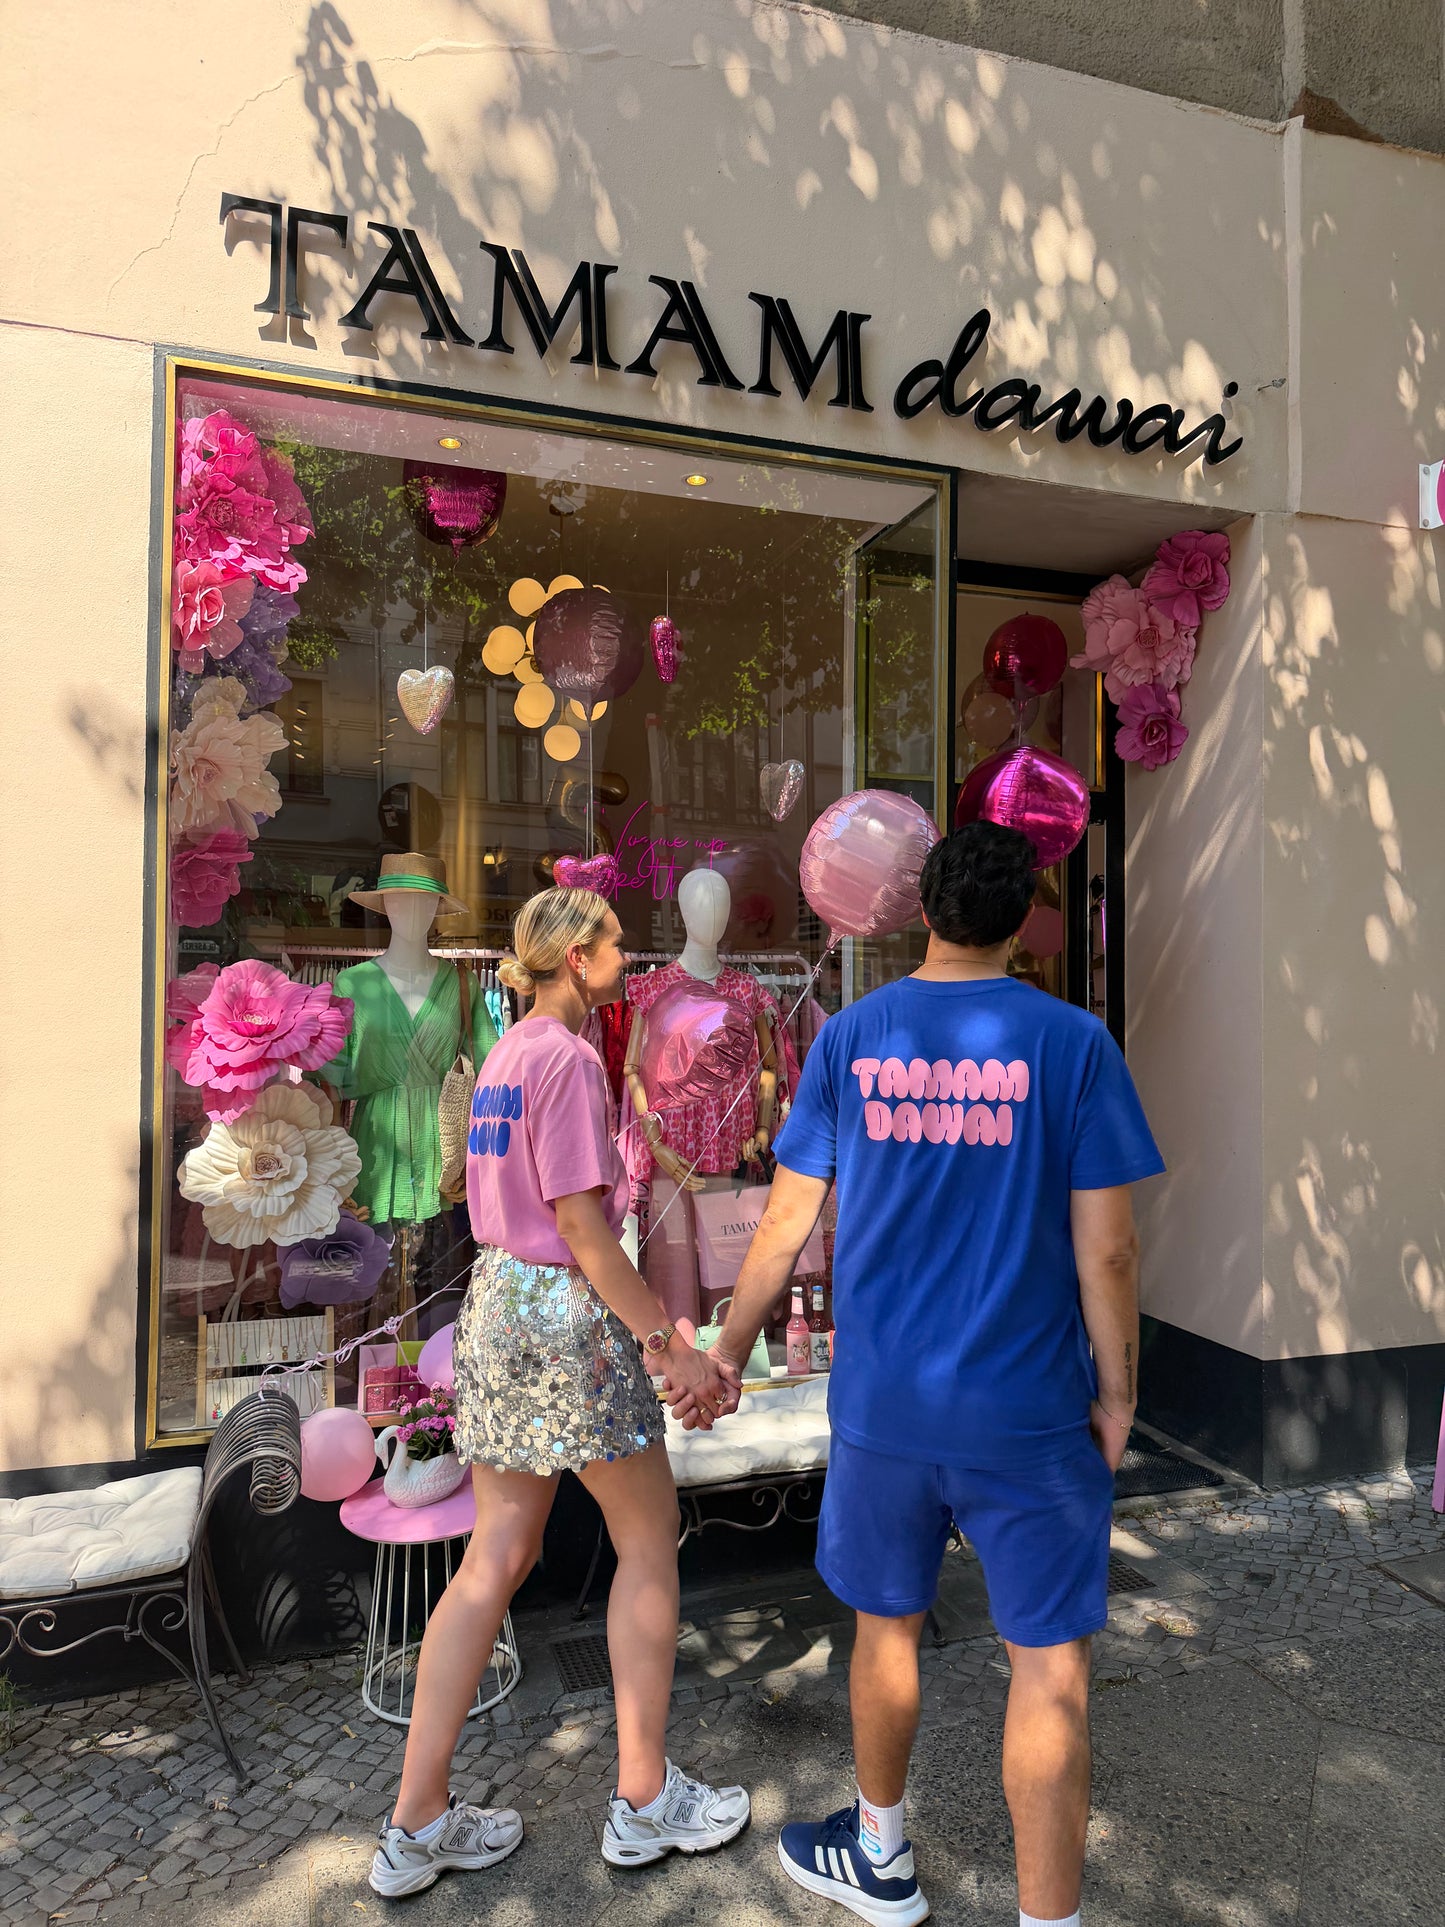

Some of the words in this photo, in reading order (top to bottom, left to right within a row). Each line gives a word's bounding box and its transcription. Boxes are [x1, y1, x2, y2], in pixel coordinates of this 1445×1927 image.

[220, 191, 873, 413] TAMAM
[893, 308, 1244, 466] dawai
[851, 1056, 1030, 1103] TAMAM
[864, 1100, 1013, 1146] DAWAI
[673, 1801, 696, 1824] N
[450, 1826, 473, 1848] N
